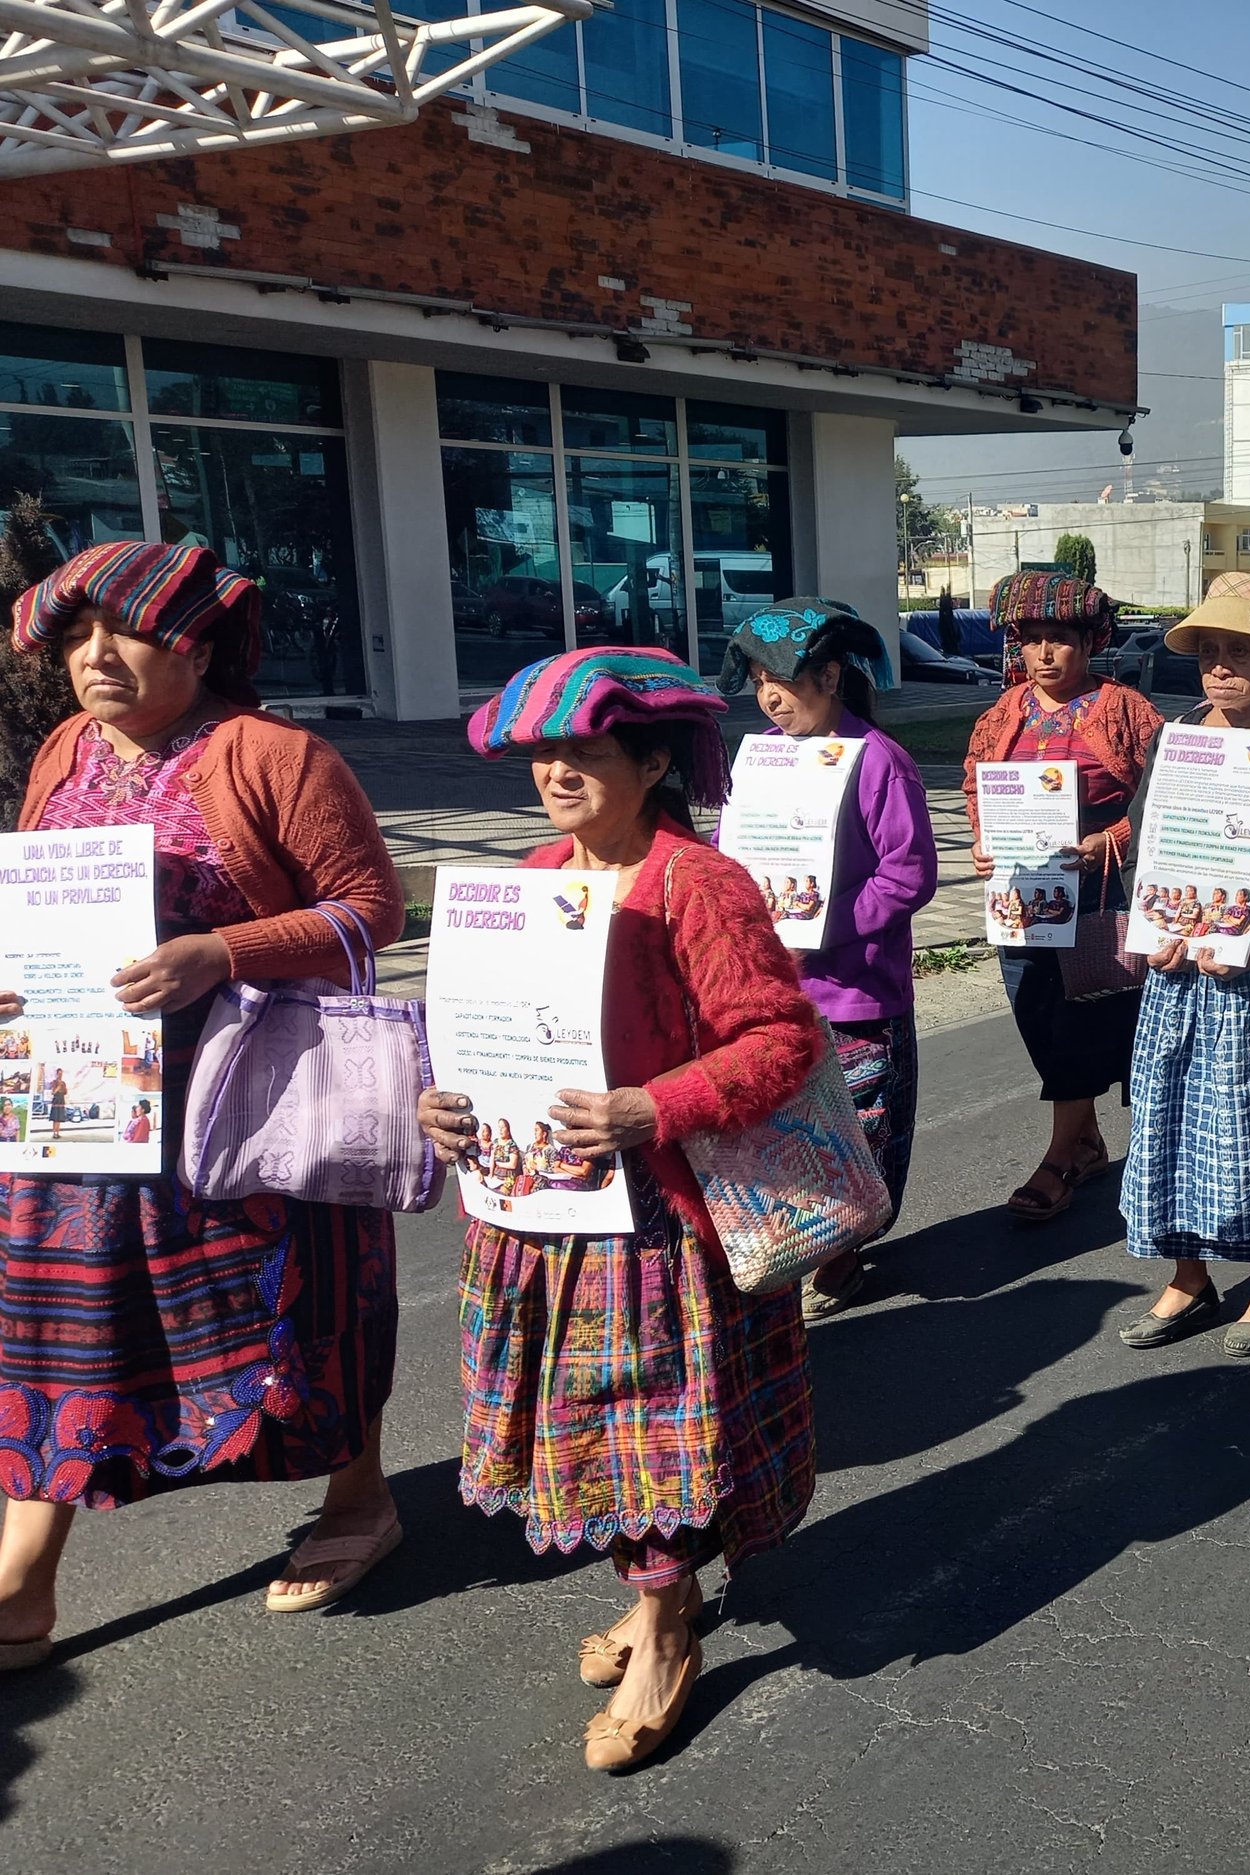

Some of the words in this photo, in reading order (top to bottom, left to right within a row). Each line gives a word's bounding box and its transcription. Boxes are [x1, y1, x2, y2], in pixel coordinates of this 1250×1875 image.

[1167, 732, 1207, 748] DECIDIR
[1208, 736, 1224, 749] ES
[1164, 749, 1177, 762] TU
[1178, 750, 1225, 766] DERECHO
[982, 771, 1008, 781] DECIDIR
[1009, 771, 1019, 781] ES
[982, 785, 990, 795] TU
[991, 784, 1024, 795] DERECHO
[23, 844, 45, 860] UNA
[48, 842, 72, 859] VIDA
[76, 841, 105, 857] LIBRE
[108, 840, 123, 856] DE
[0, 867, 56, 884] VIOLENCIA
[60, 867, 74, 881] ES
[78, 865, 90, 880] UN
[27, 891, 41, 906] NO
[45, 890, 59, 905] UN
[62, 887, 122, 905] PRIVILEGIO
[448, 882, 502, 902] DECIDIR
[503, 885, 521, 903] ES
[446, 908, 462, 927] TU
[464, 910, 526, 931] DERECHO
[556, 1028, 591, 1040] LEYDEM
